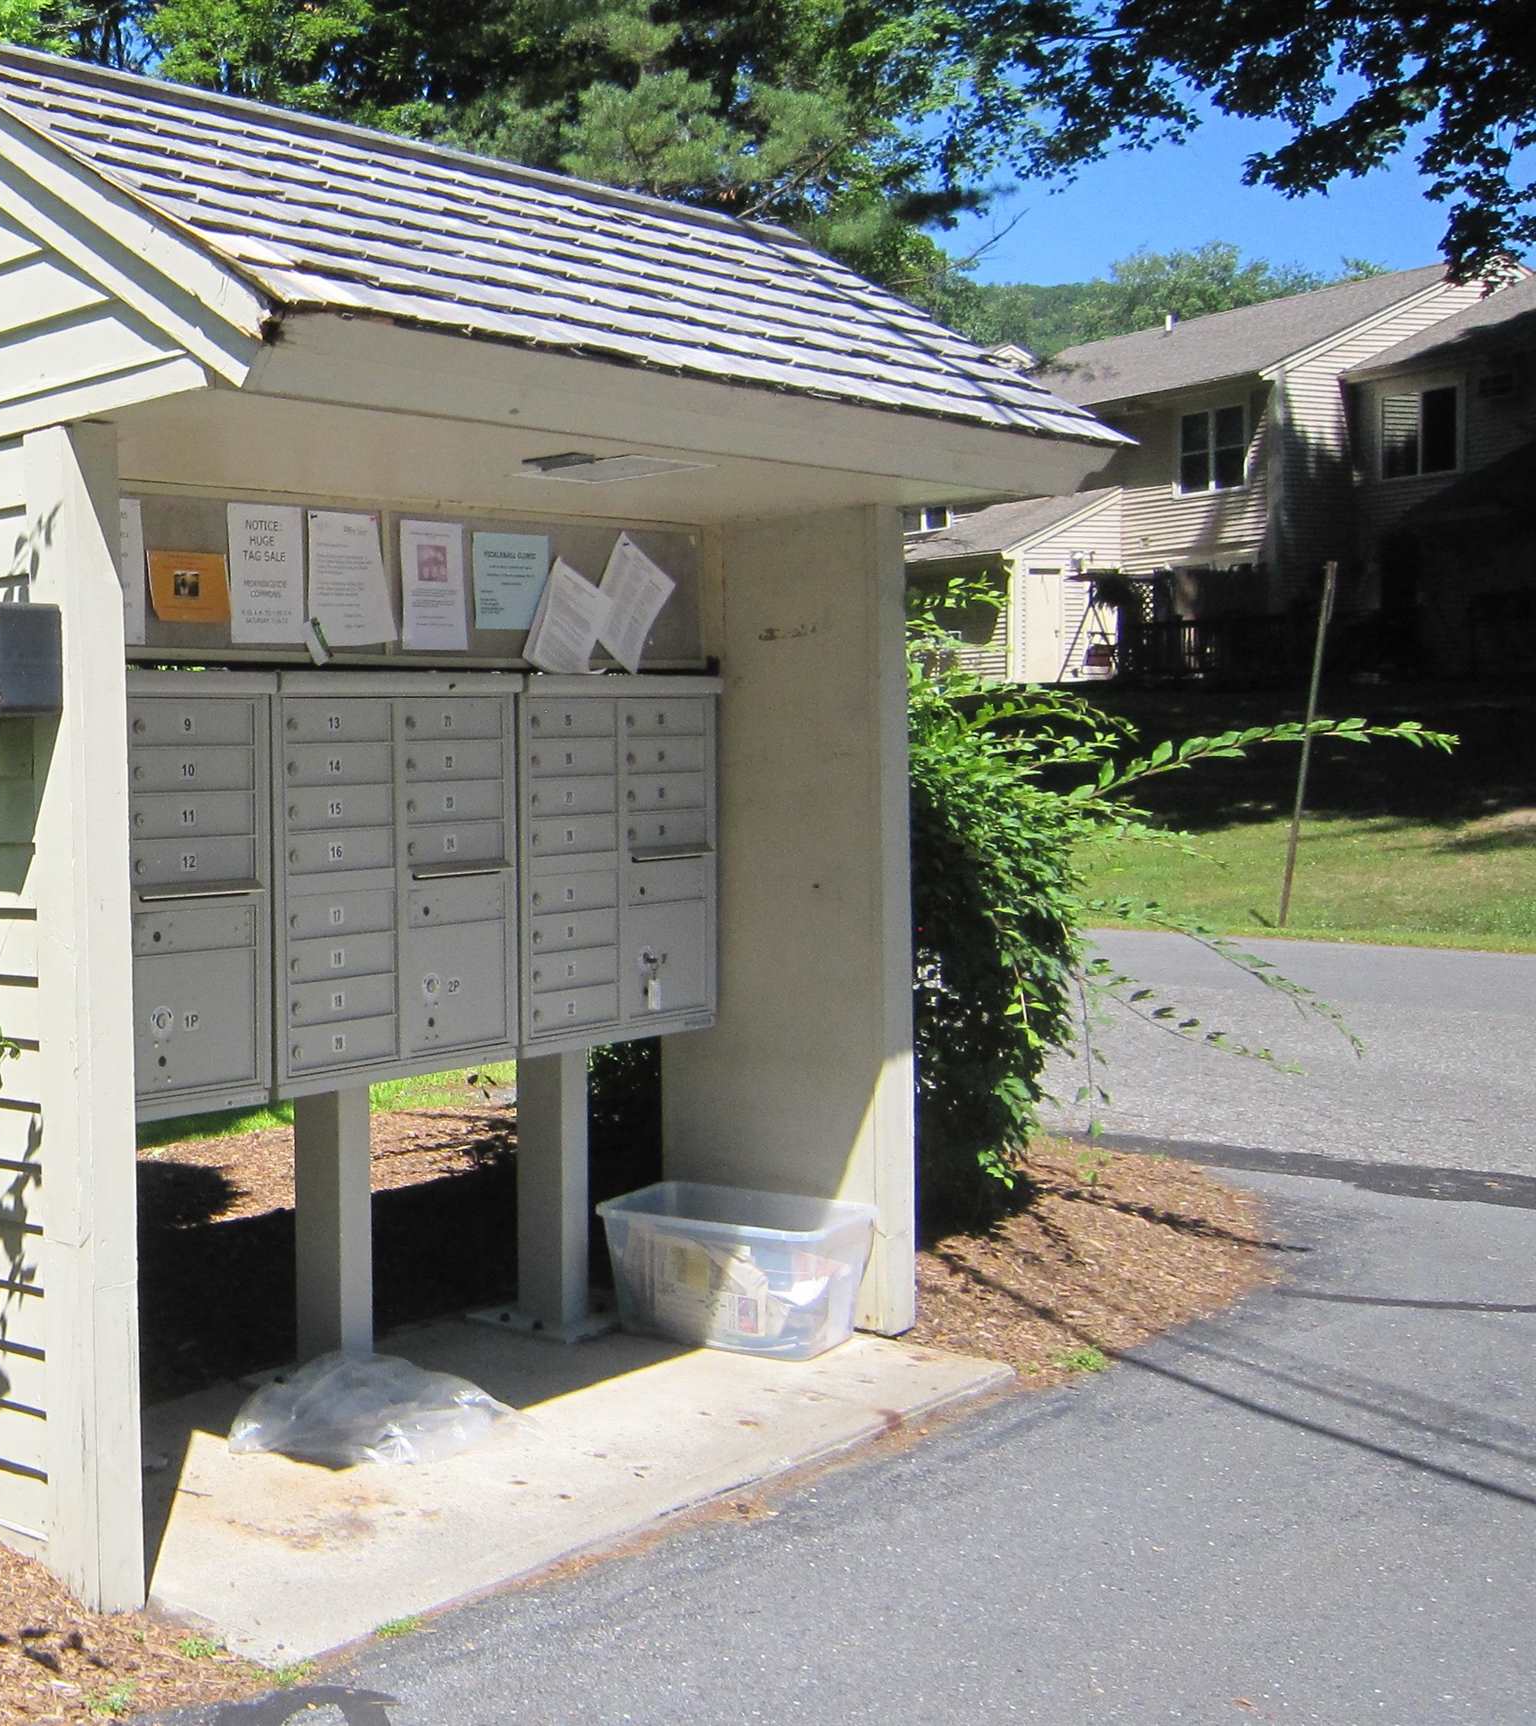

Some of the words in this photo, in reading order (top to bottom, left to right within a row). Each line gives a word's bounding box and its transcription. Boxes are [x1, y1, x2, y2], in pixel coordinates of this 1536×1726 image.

[249, 535, 275, 547] HUGE
[242, 550, 262, 561] TAG
[263, 551, 286, 562] SALE
[183, 718, 192, 732] 9
[327, 716, 341, 730] 13
[182, 763, 195, 777] 10
[328, 759, 341, 773] 14
[182, 809, 195, 823] 11
[329, 802, 342, 816] 15
[330, 845, 343, 859] 16
[182, 855, 196, 869] 12
[332, 909, 342, 923] 17
[447, 979, 461, 994] 2P
[184, 1013, 199, 1028] 1P
